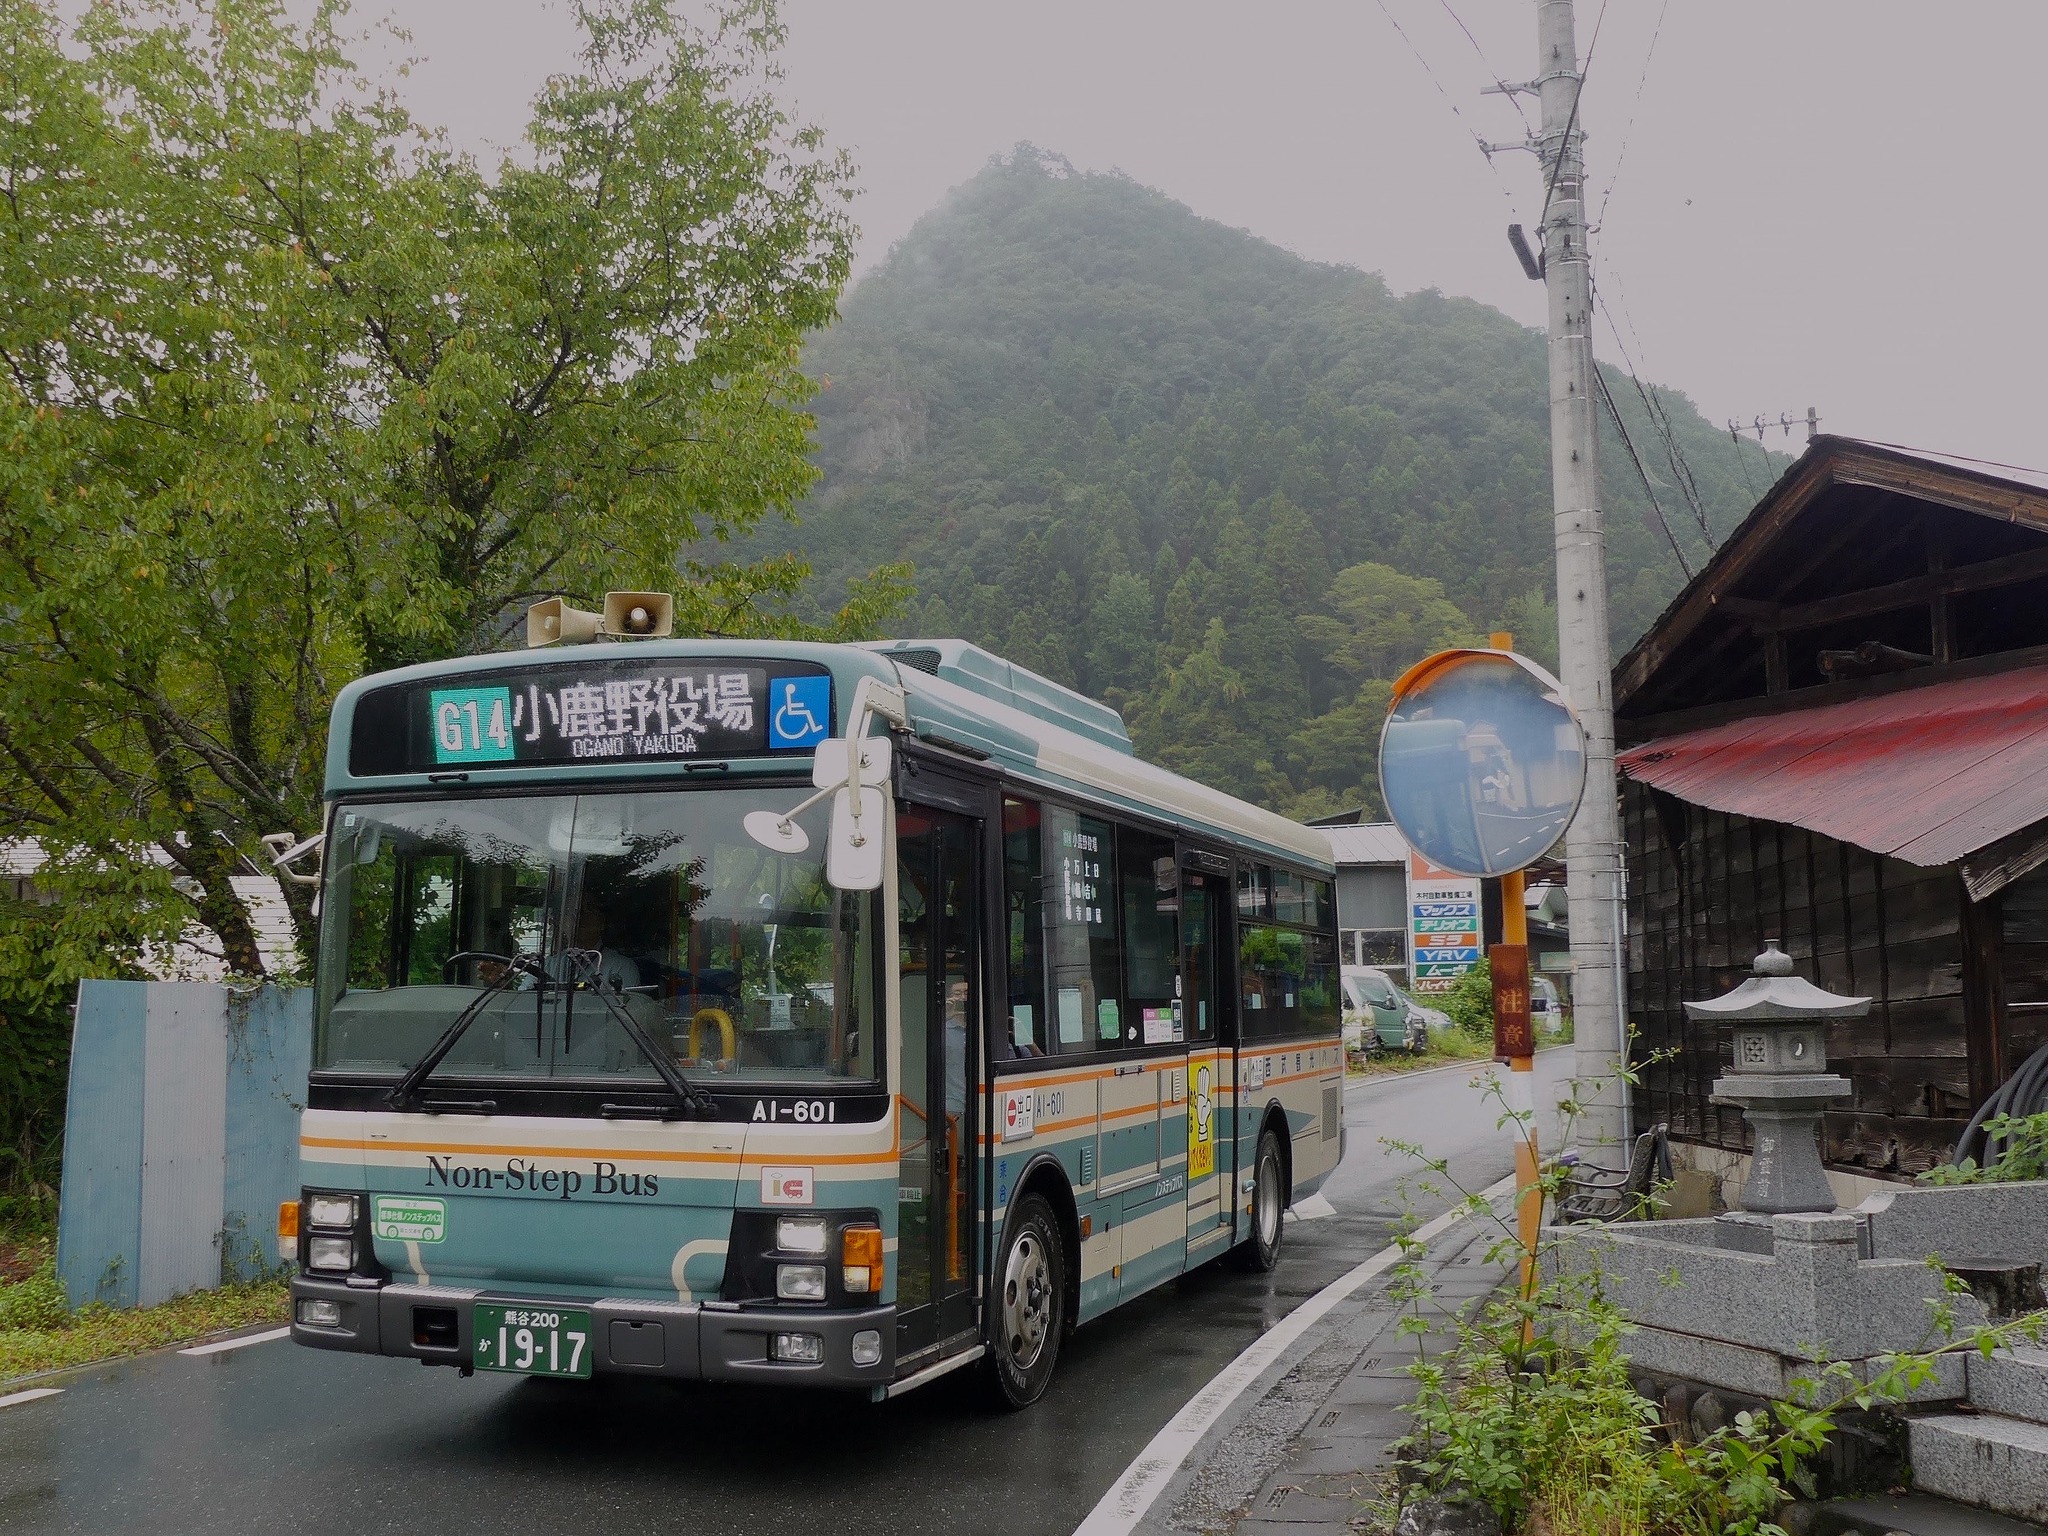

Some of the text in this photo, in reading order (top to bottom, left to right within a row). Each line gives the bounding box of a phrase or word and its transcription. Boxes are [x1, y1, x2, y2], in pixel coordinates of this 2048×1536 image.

[513, 673, 754, 741] 小鹿野役場
[437, 700, 508, 751] G14
[572, 732, 696, 757] OGANO YAKUBA
[1419, 904, 1471, 916] マックス
[1420, 919, 1471, 931] テリオス
[1428, 934, 1463, 946] ミラ
[1423, 949, 1470, 961] YRV
[1017, 1094, 1032, 1115] 出口
[1018, 1116, 1030, 1128] EXIT
[425, 1155, 659, 1200] Non-Step Bus
[478, 1326, 586, 1373] か 19-17
